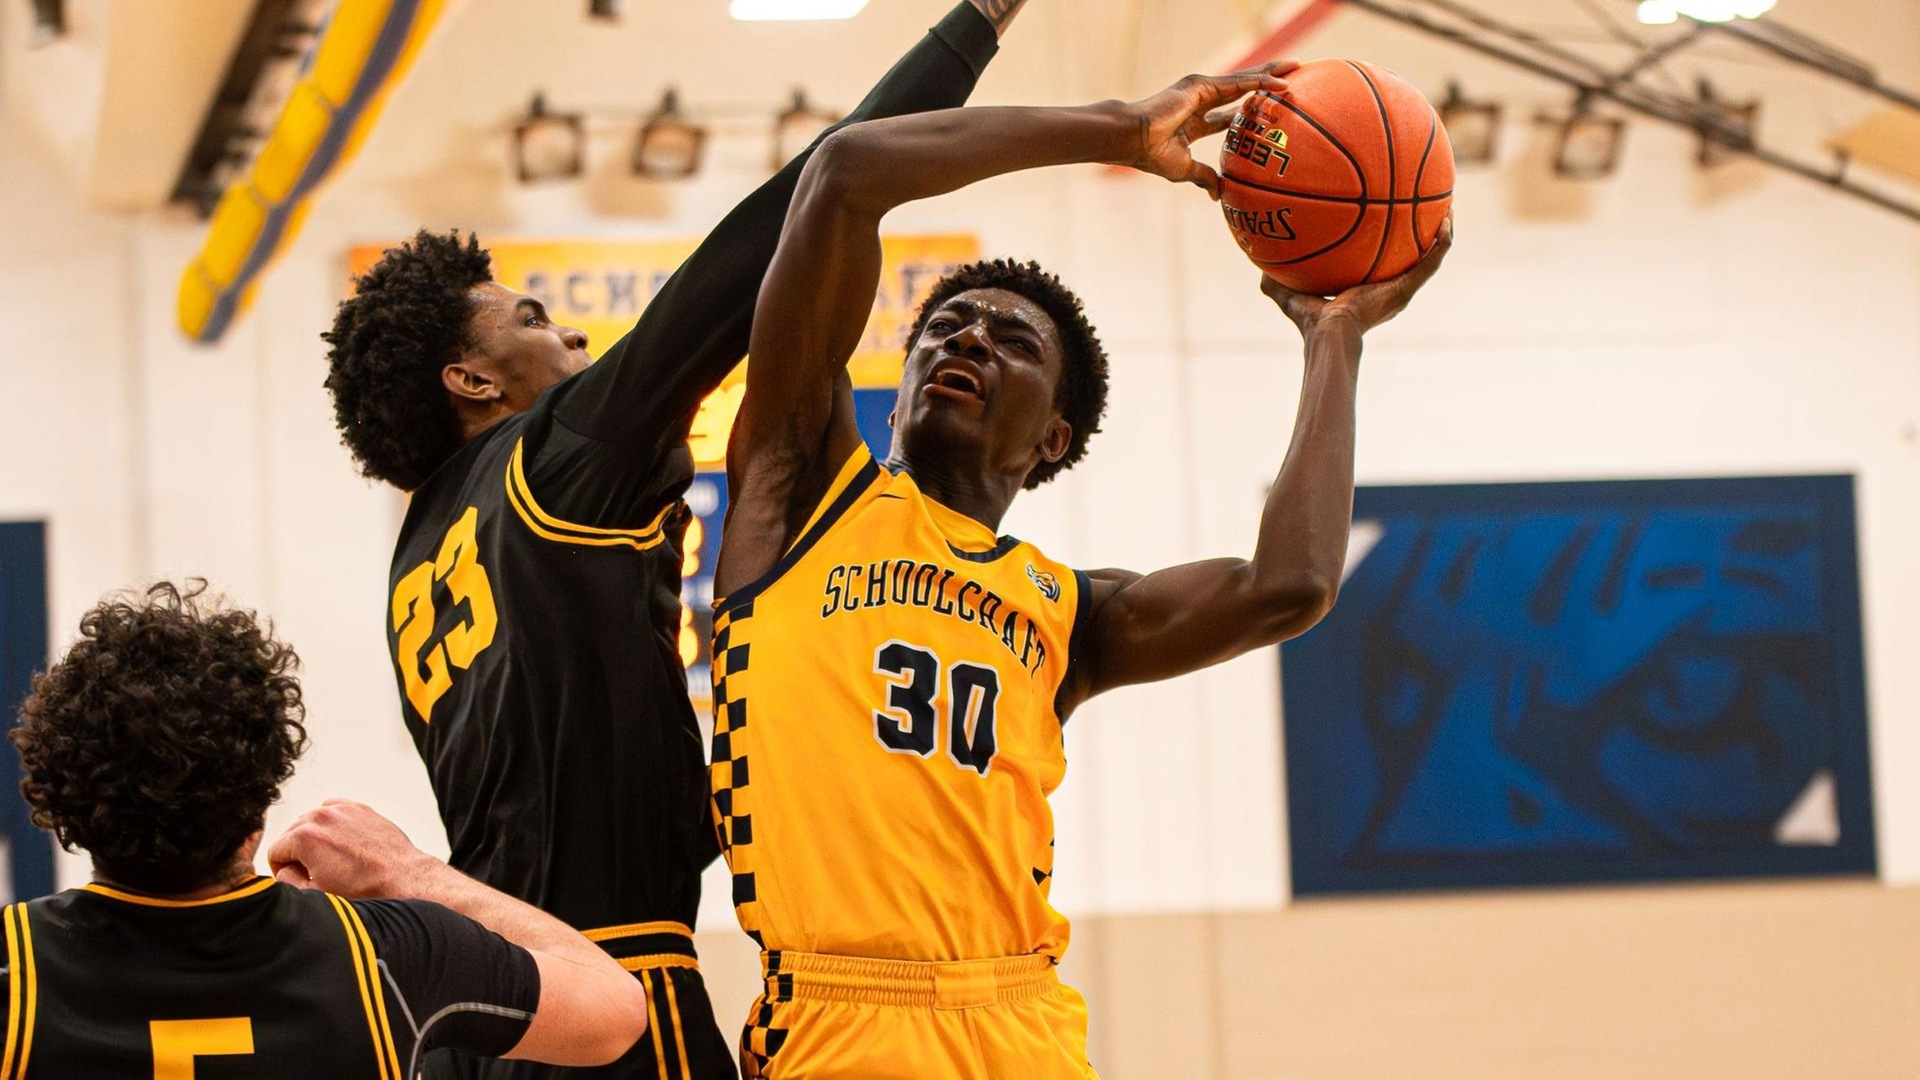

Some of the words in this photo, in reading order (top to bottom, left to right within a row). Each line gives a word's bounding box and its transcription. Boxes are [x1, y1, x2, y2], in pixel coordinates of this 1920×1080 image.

[393, 506, 498, 725] 23
[821, 559, 1046, 681] SCHOOLCRAFT
[872, 638, 1000, 778] 30
